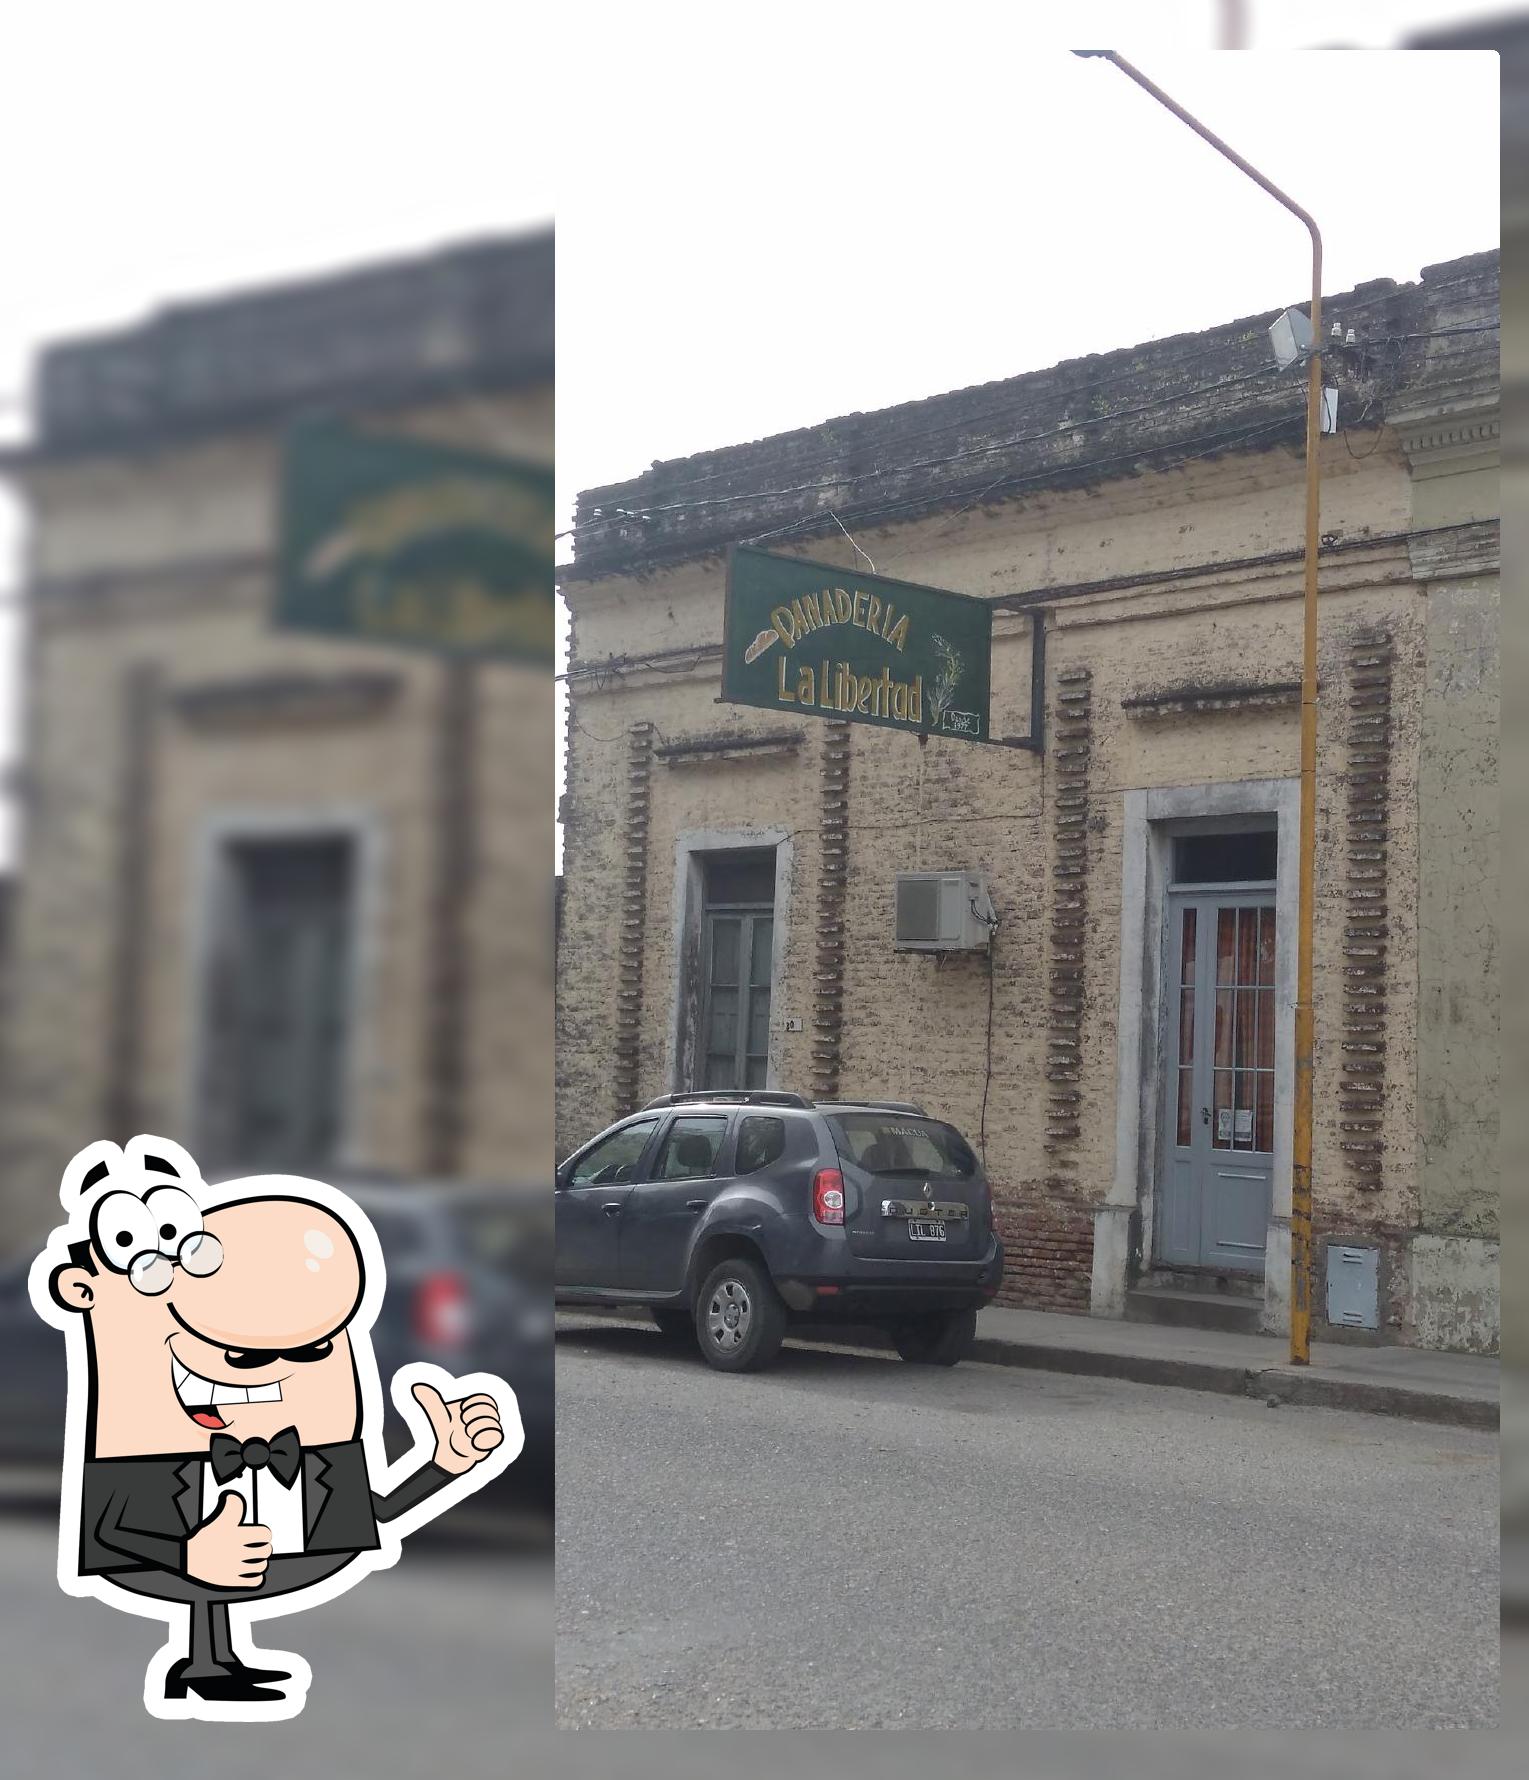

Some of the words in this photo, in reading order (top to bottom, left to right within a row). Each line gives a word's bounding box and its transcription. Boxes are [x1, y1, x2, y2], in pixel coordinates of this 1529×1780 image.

[771, 588, 909, 652] PANADERIA
[778, 656, 815, 706] La
[820, 660, 923, 723] Libertad
[910, 1223, 926, 1236] LIL
[929, 1224, 945, 1237] 876
